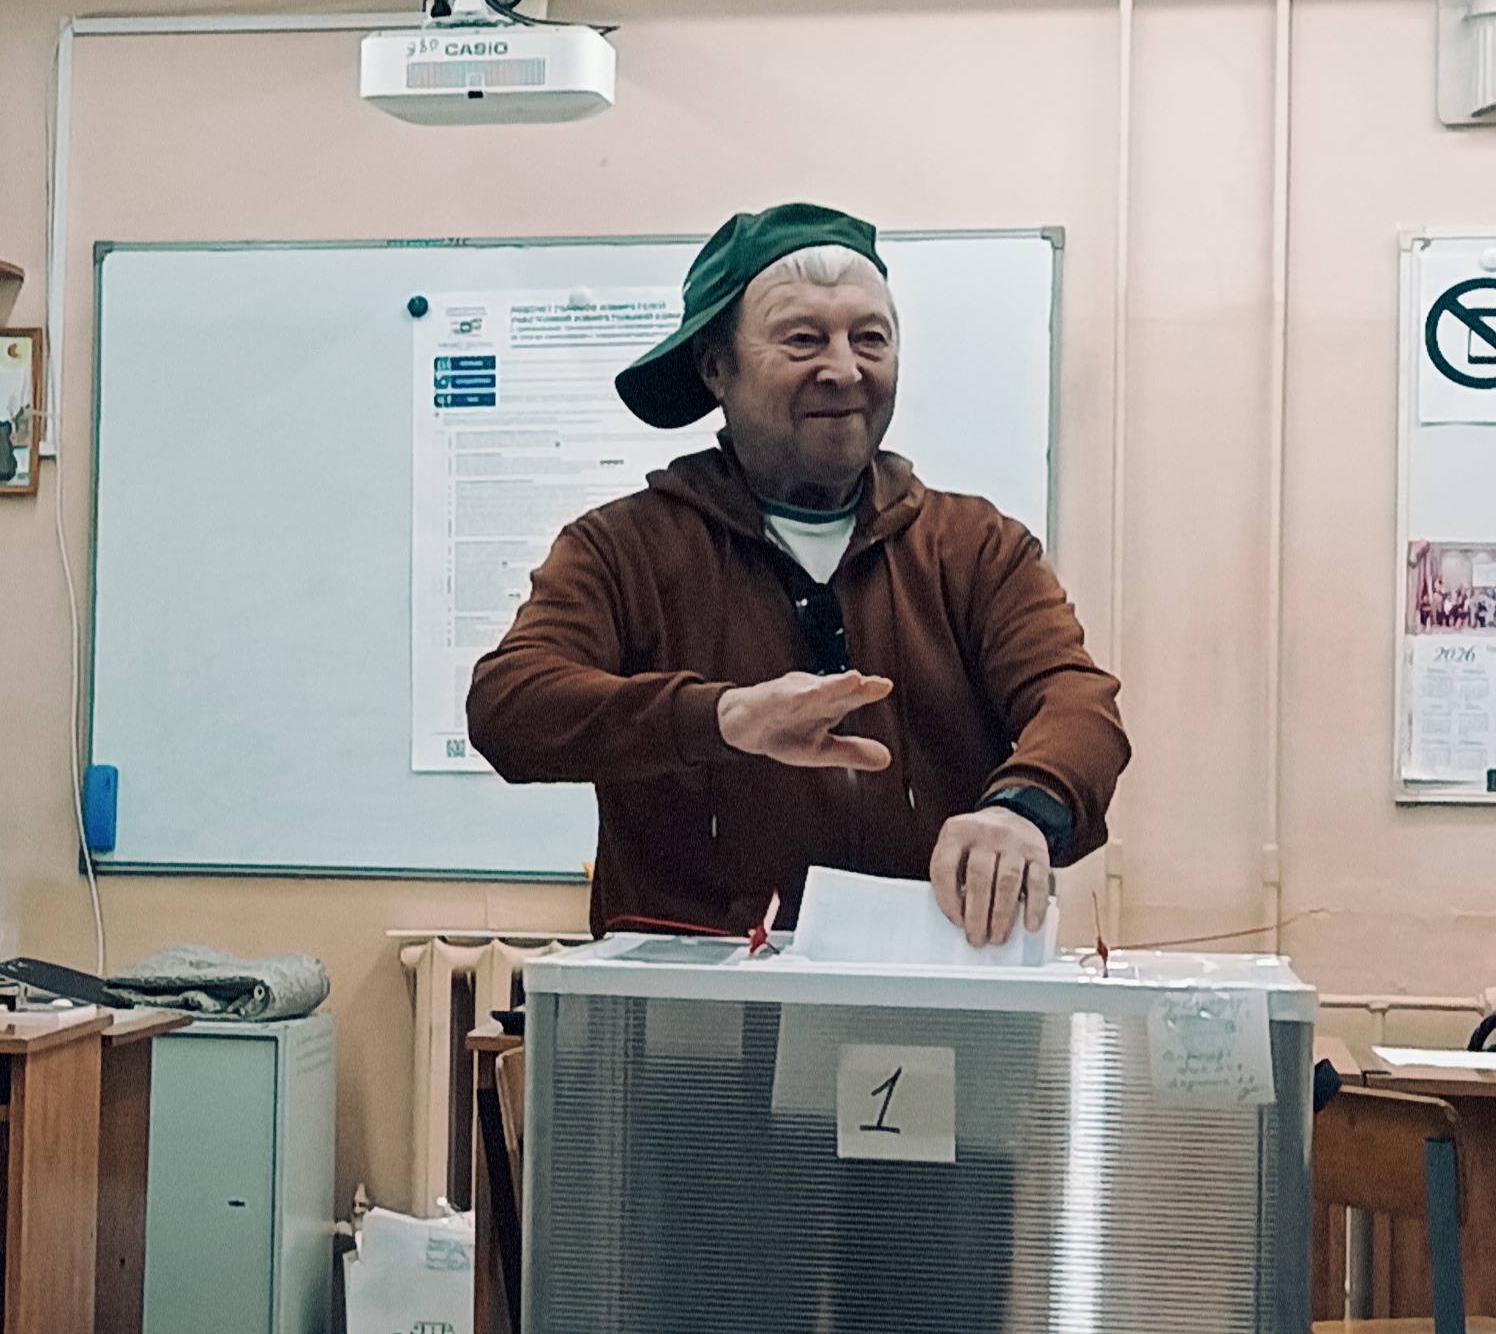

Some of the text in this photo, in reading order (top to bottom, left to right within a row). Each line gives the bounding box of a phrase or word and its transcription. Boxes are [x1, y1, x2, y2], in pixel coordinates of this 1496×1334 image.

[445, 41, 509, 56] CASIO
[1433, 646, 1477, 663] 2026
[859, 1067, 902, 1134] 1
